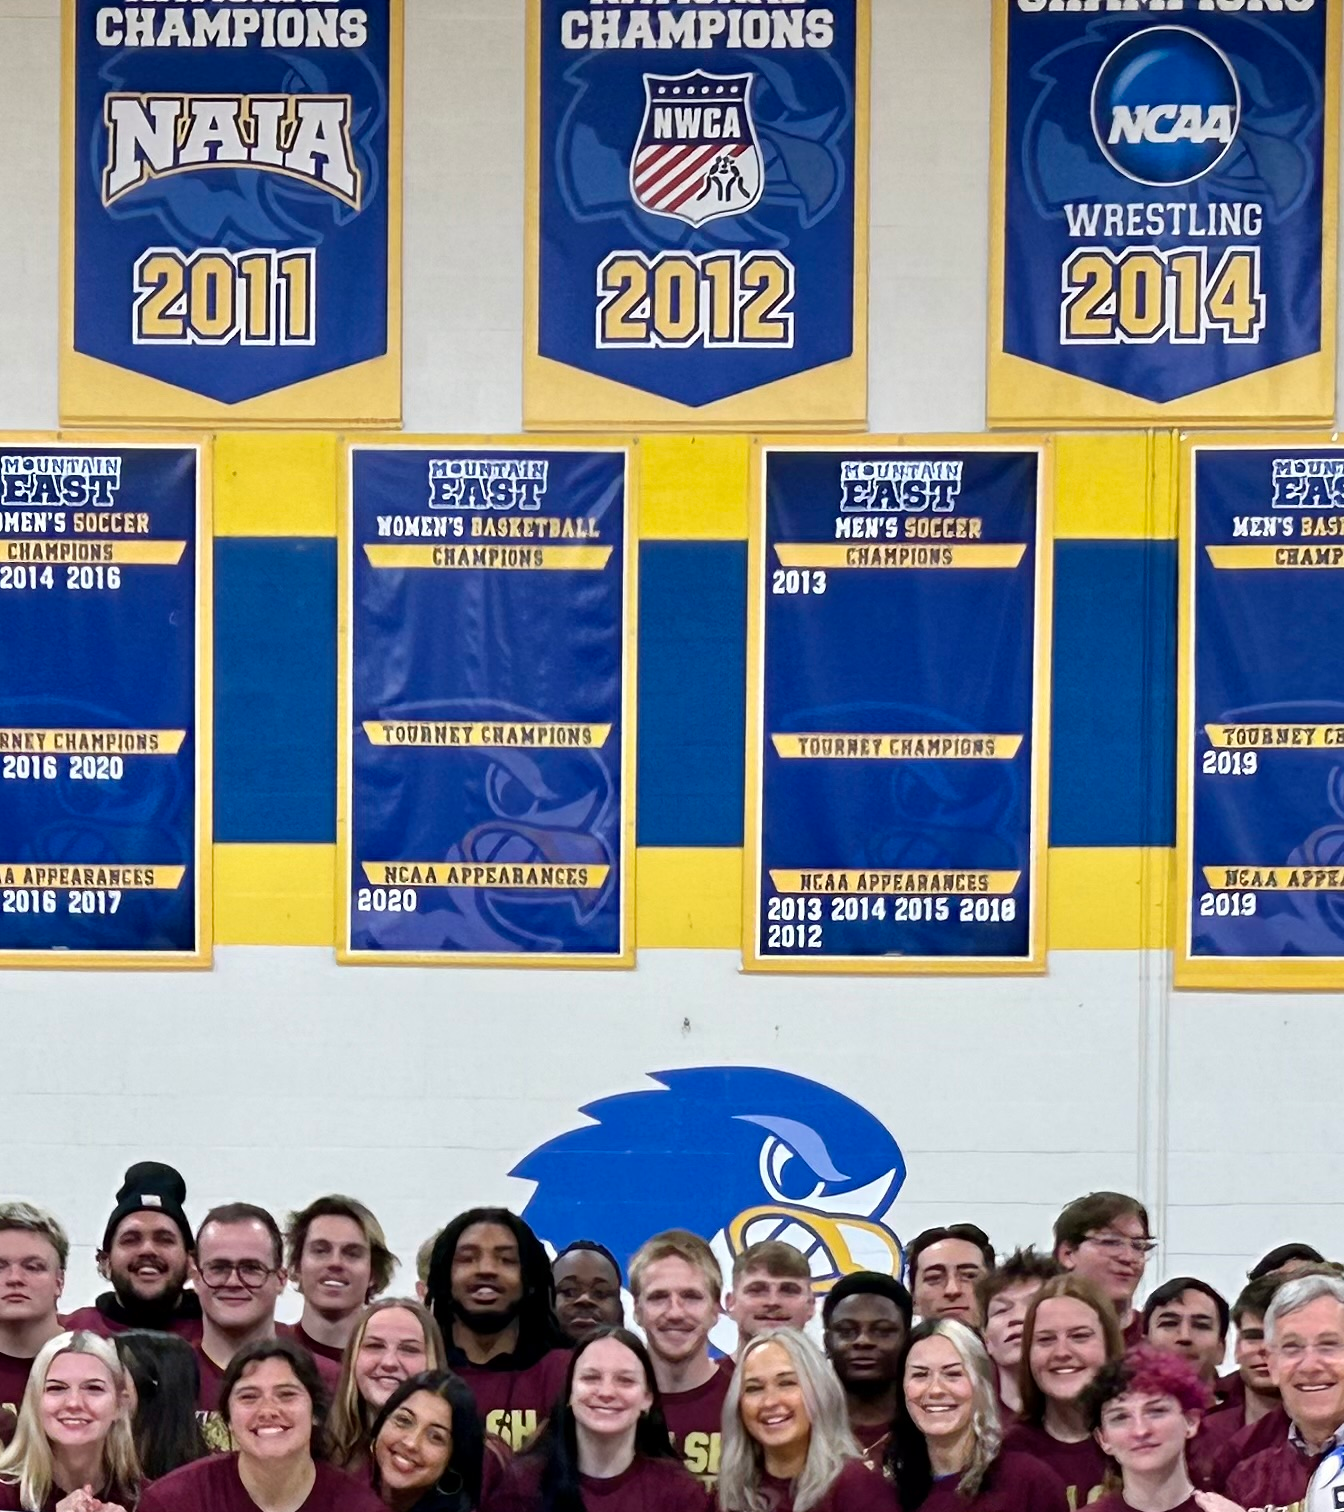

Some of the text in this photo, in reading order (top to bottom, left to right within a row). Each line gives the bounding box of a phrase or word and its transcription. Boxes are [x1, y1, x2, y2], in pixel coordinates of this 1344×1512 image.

[96, 8, 367, 48] CHAMPIONS
[560, 10, 833, 50] CHAMPIONS
[653, 106, 740, 139] NWCA
[1107, 104, 1235, 145] NCAA
[104, 95, 360, 208] NAIA
[1064, 203, 1262, 238] WRESTLING
[133, 247, 317, 347] 2011
[596, 249, 795, 349] 2012
[1060, 245, 1266, 345] 2014
[1, 455, 121, 478] MOUNTAIN
[429, 459, 549, 482] MOUNTAIN
[1, 476, 119, 507] EAST
[429, 479, 547, 510] EAST
[841, 480, 960, 512] EAST
[73, 512, 149, 533] SOCCER
[378, 517, 600, 538] WOMEN'S BASKETBALL
[835, 518, 981, 539] MEN'S SOCCER
[1233, 517, 1294, 537] MEN'S
[7, 542, 113, 561] CHAMPIONS
[433, 547, 544, 567] CHAMPIONS
[846, 547, 952, 566] CHAMPIONS
[0, 566, 54, 590] 2014
[67, 566, 120, 590] 2016
[773, 571, 826, 595] 2013
[54, 731, 158, 751] CHAMPIONS
[383, 725, 592, 746] TOURNEY CHAMPIONS
[798, 737, 995, 757] TOURNEY CHAMPIONS
[1223, 726, 1315, 746] TOURNEY
[3, 756, 57, 780] 2016
[69, 756, 123, 780] 2020
[1203, 751, 1257, 775] 2019
[23, 867, 154, 887] APPEARANCES
[385, 866, 588, 887] NCAA APPEARANCES
[799, 873, 988, 892] NCAA APPEARANCES
[1225, 869, 1279, 888] NCAA
[2, 890, 57, 914] 2016
[68, 890, 121, 914] 2017
[358, 889, 417, 913] 2020
[768, 898, 822, 921] 2013
[831, 898, 886, 921] 2014
[895, 898, 949, 921] 2015
[1200, 893, 1256, 917] 2019
[768, 925, 822, 949] 2012
